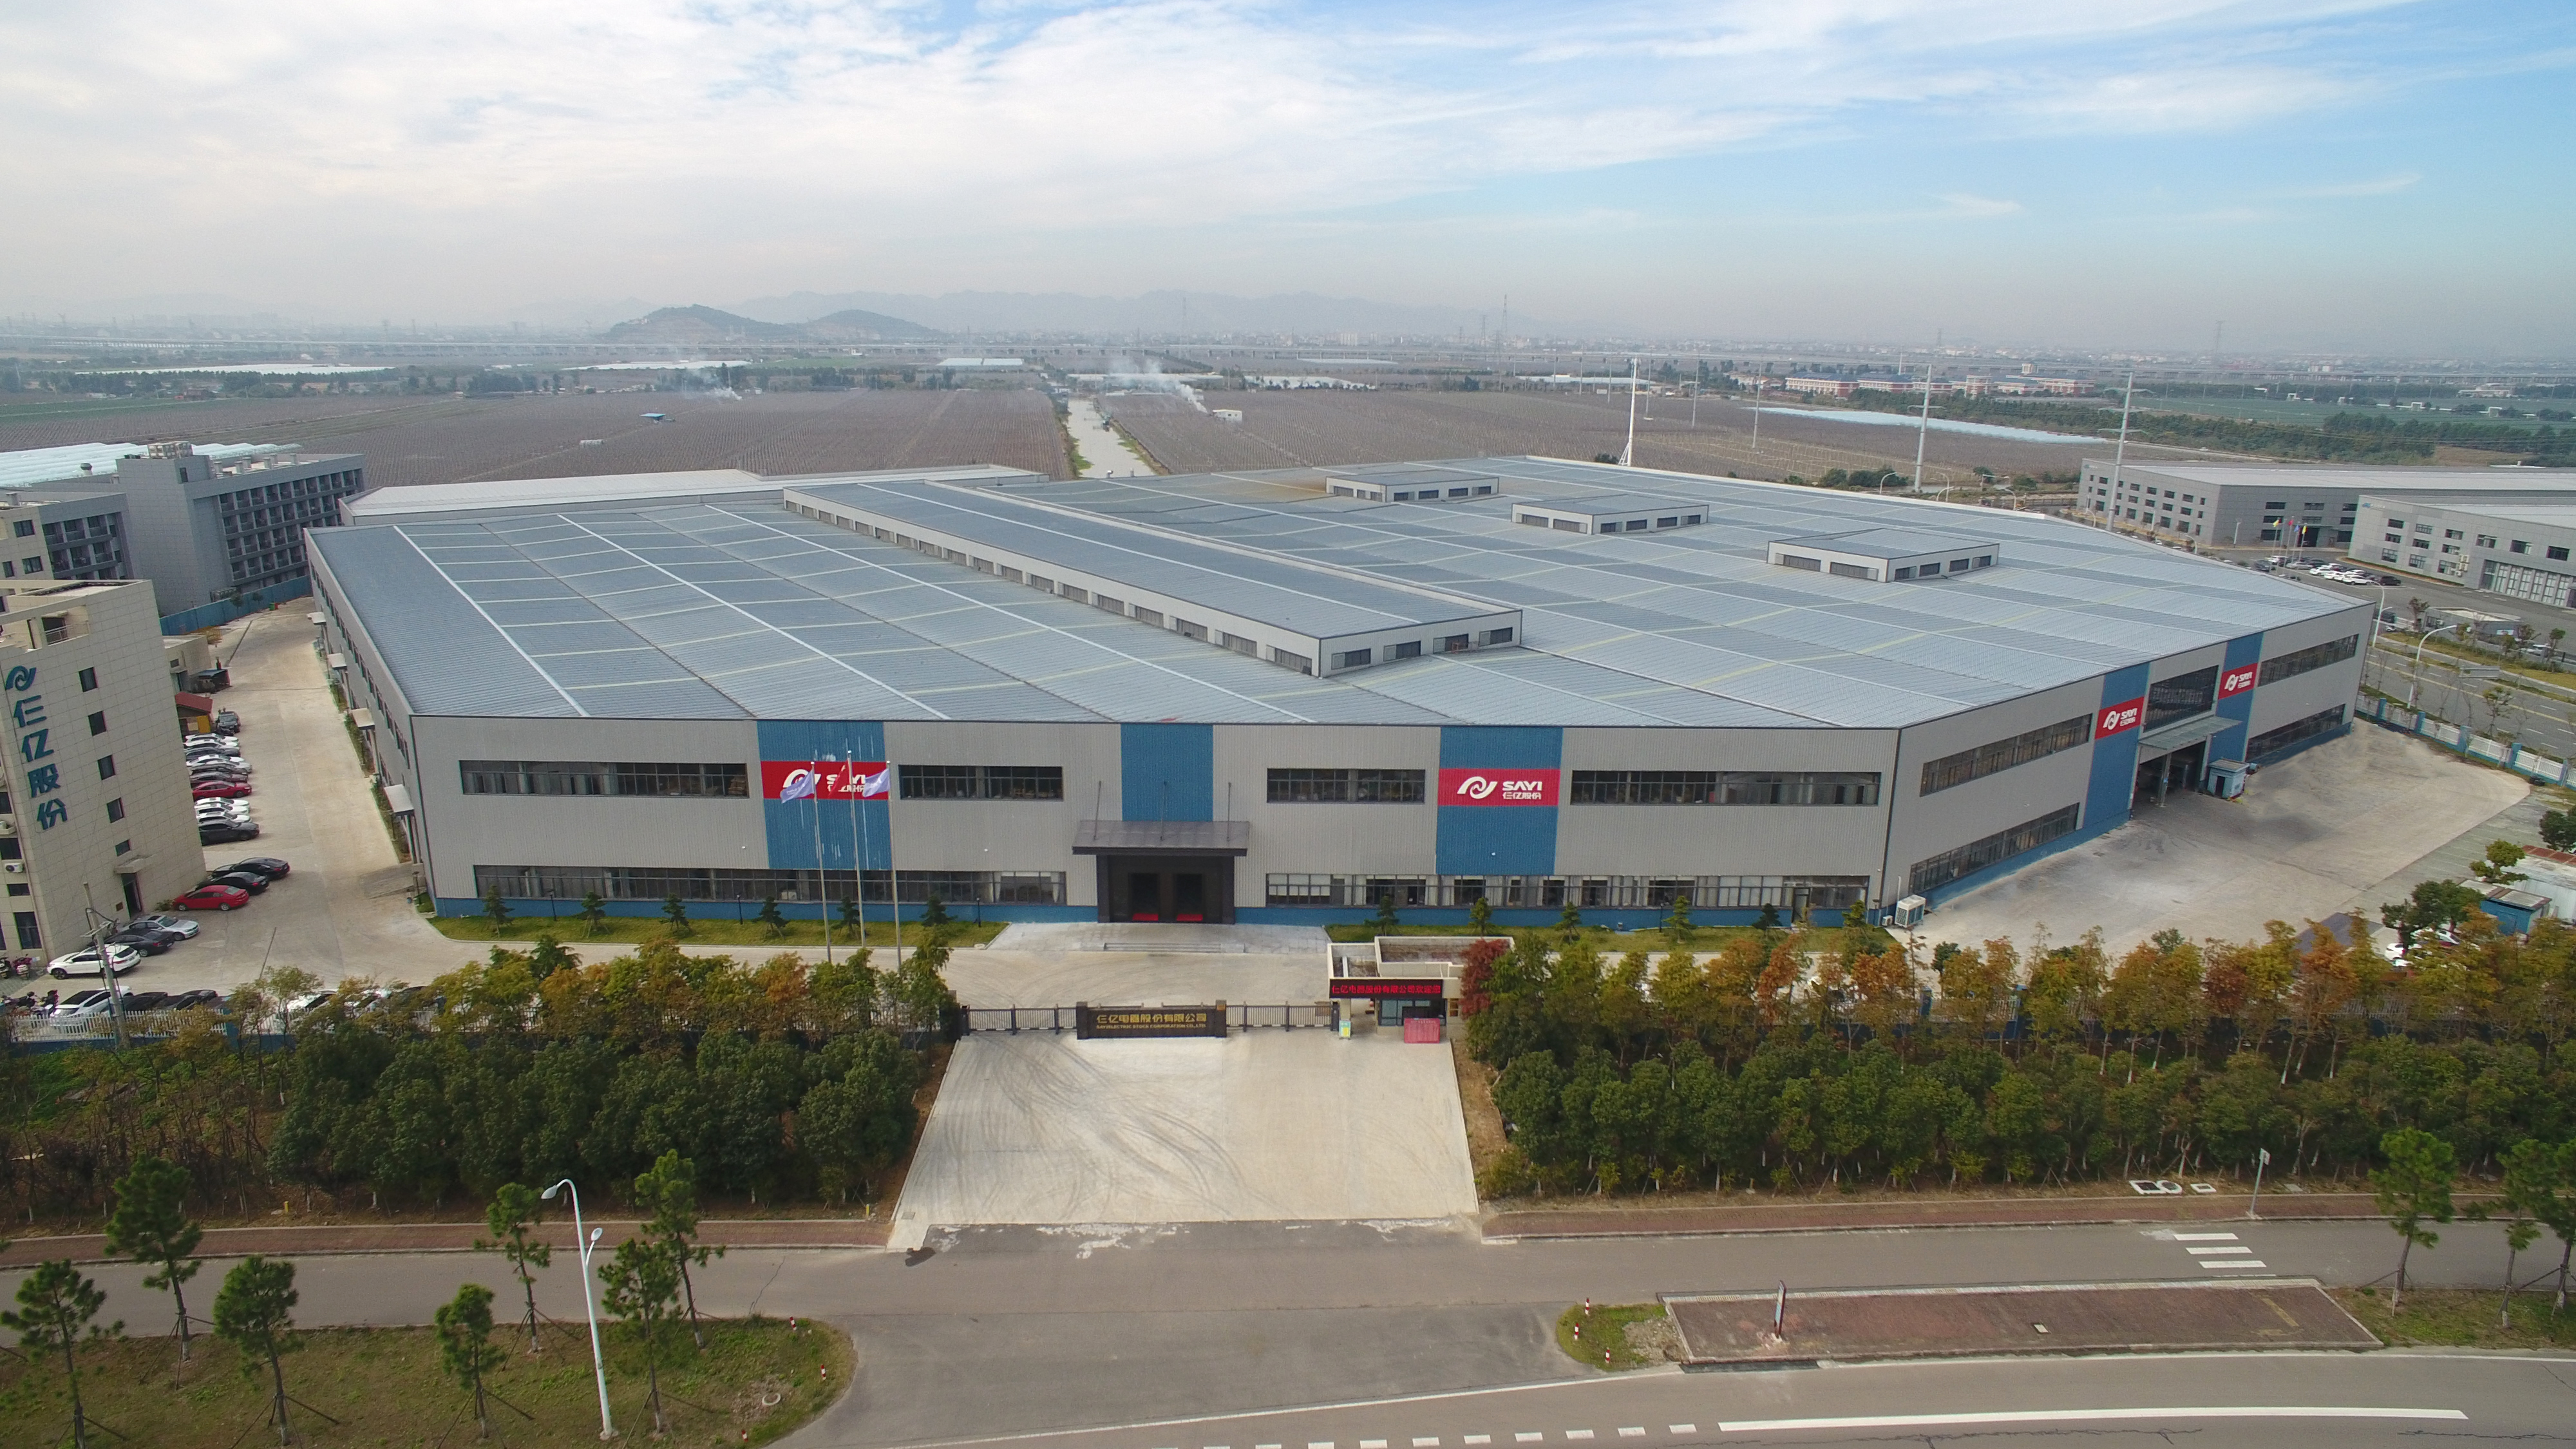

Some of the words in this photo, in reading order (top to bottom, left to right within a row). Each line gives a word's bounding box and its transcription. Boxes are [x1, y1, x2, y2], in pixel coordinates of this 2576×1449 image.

[2120, 708, 2137, 719] SAYI
[14, 695, 68, 830] 仨亿股份
[826, 774, 866, 784] SYI
[1502, 781, 1542, 791] SAYI
[1097, 1014, 1206, 1023] 仨亿电器股份有限公司
